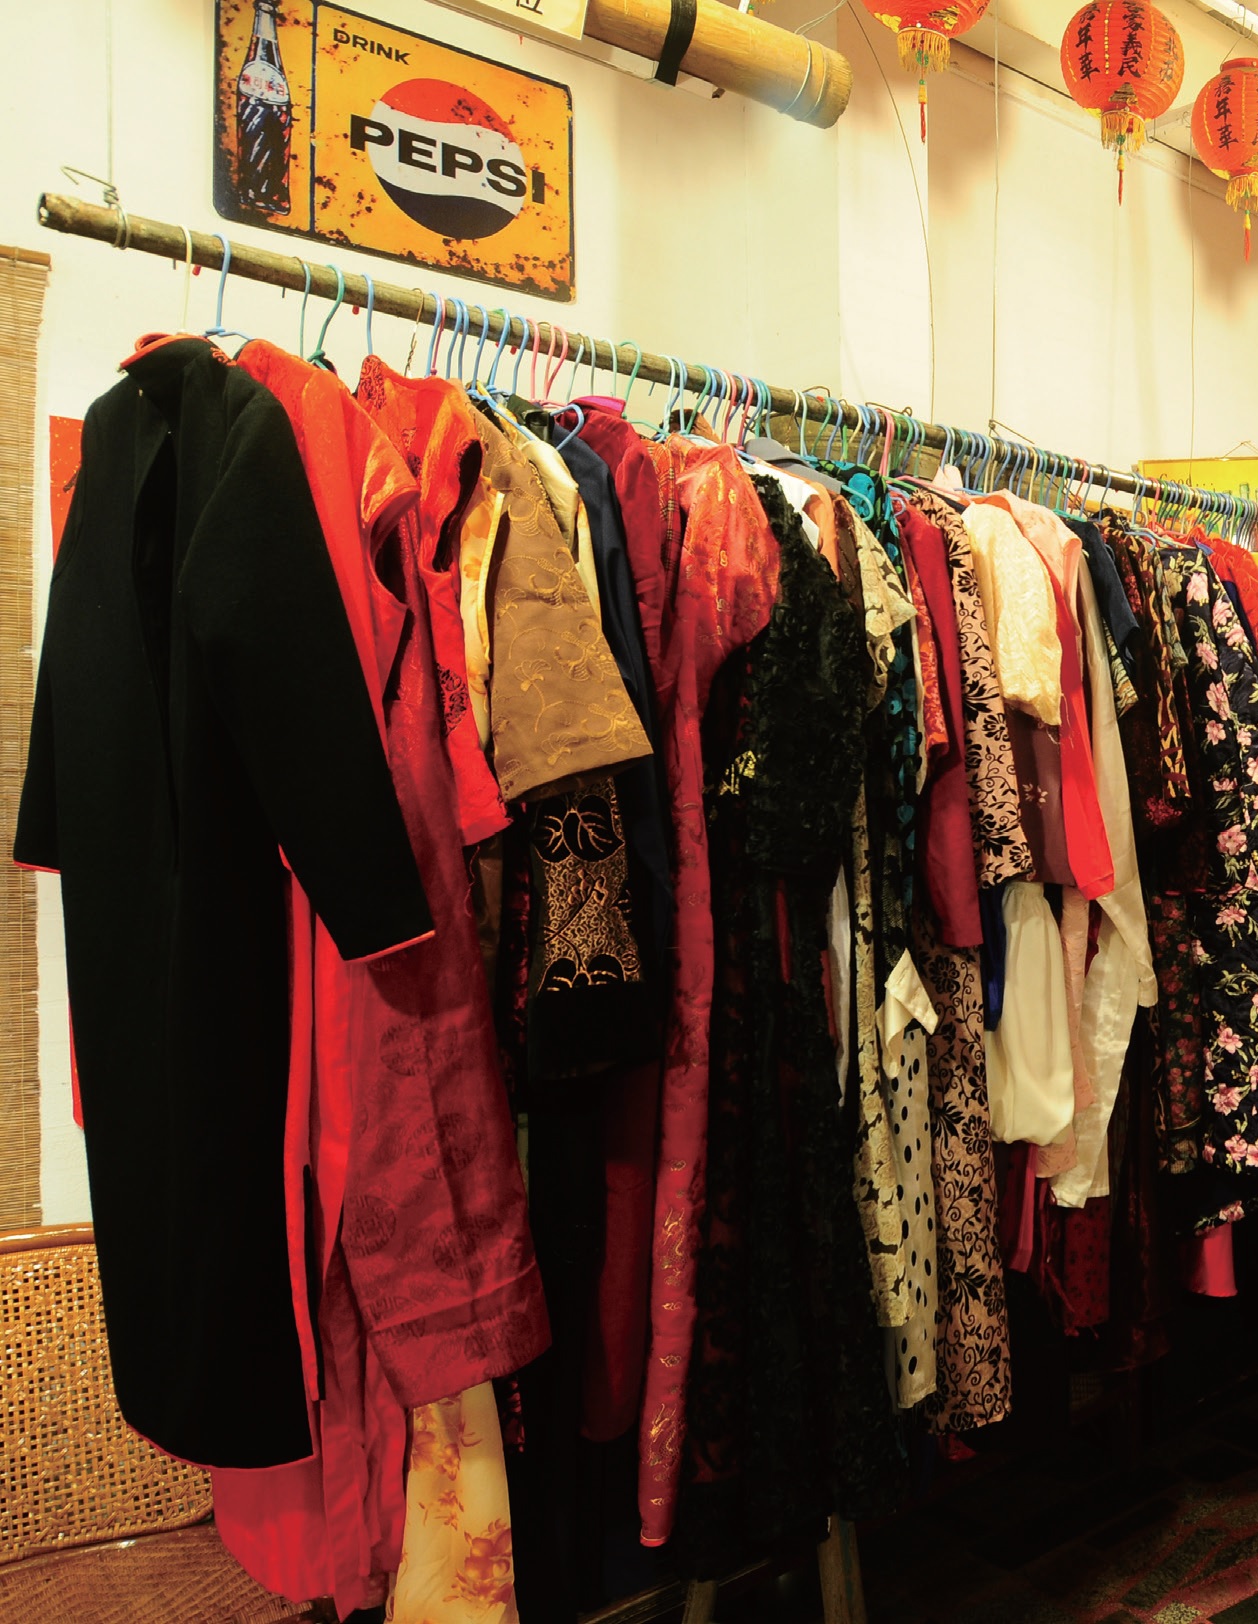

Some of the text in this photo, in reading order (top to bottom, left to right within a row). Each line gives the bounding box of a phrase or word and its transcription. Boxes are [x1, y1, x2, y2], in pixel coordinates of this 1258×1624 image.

[333, 27, 410, 65] DRINK
[1214, 75, 1239, 151] 嘉年華
[350, 114, 545, 204] PEPSI
